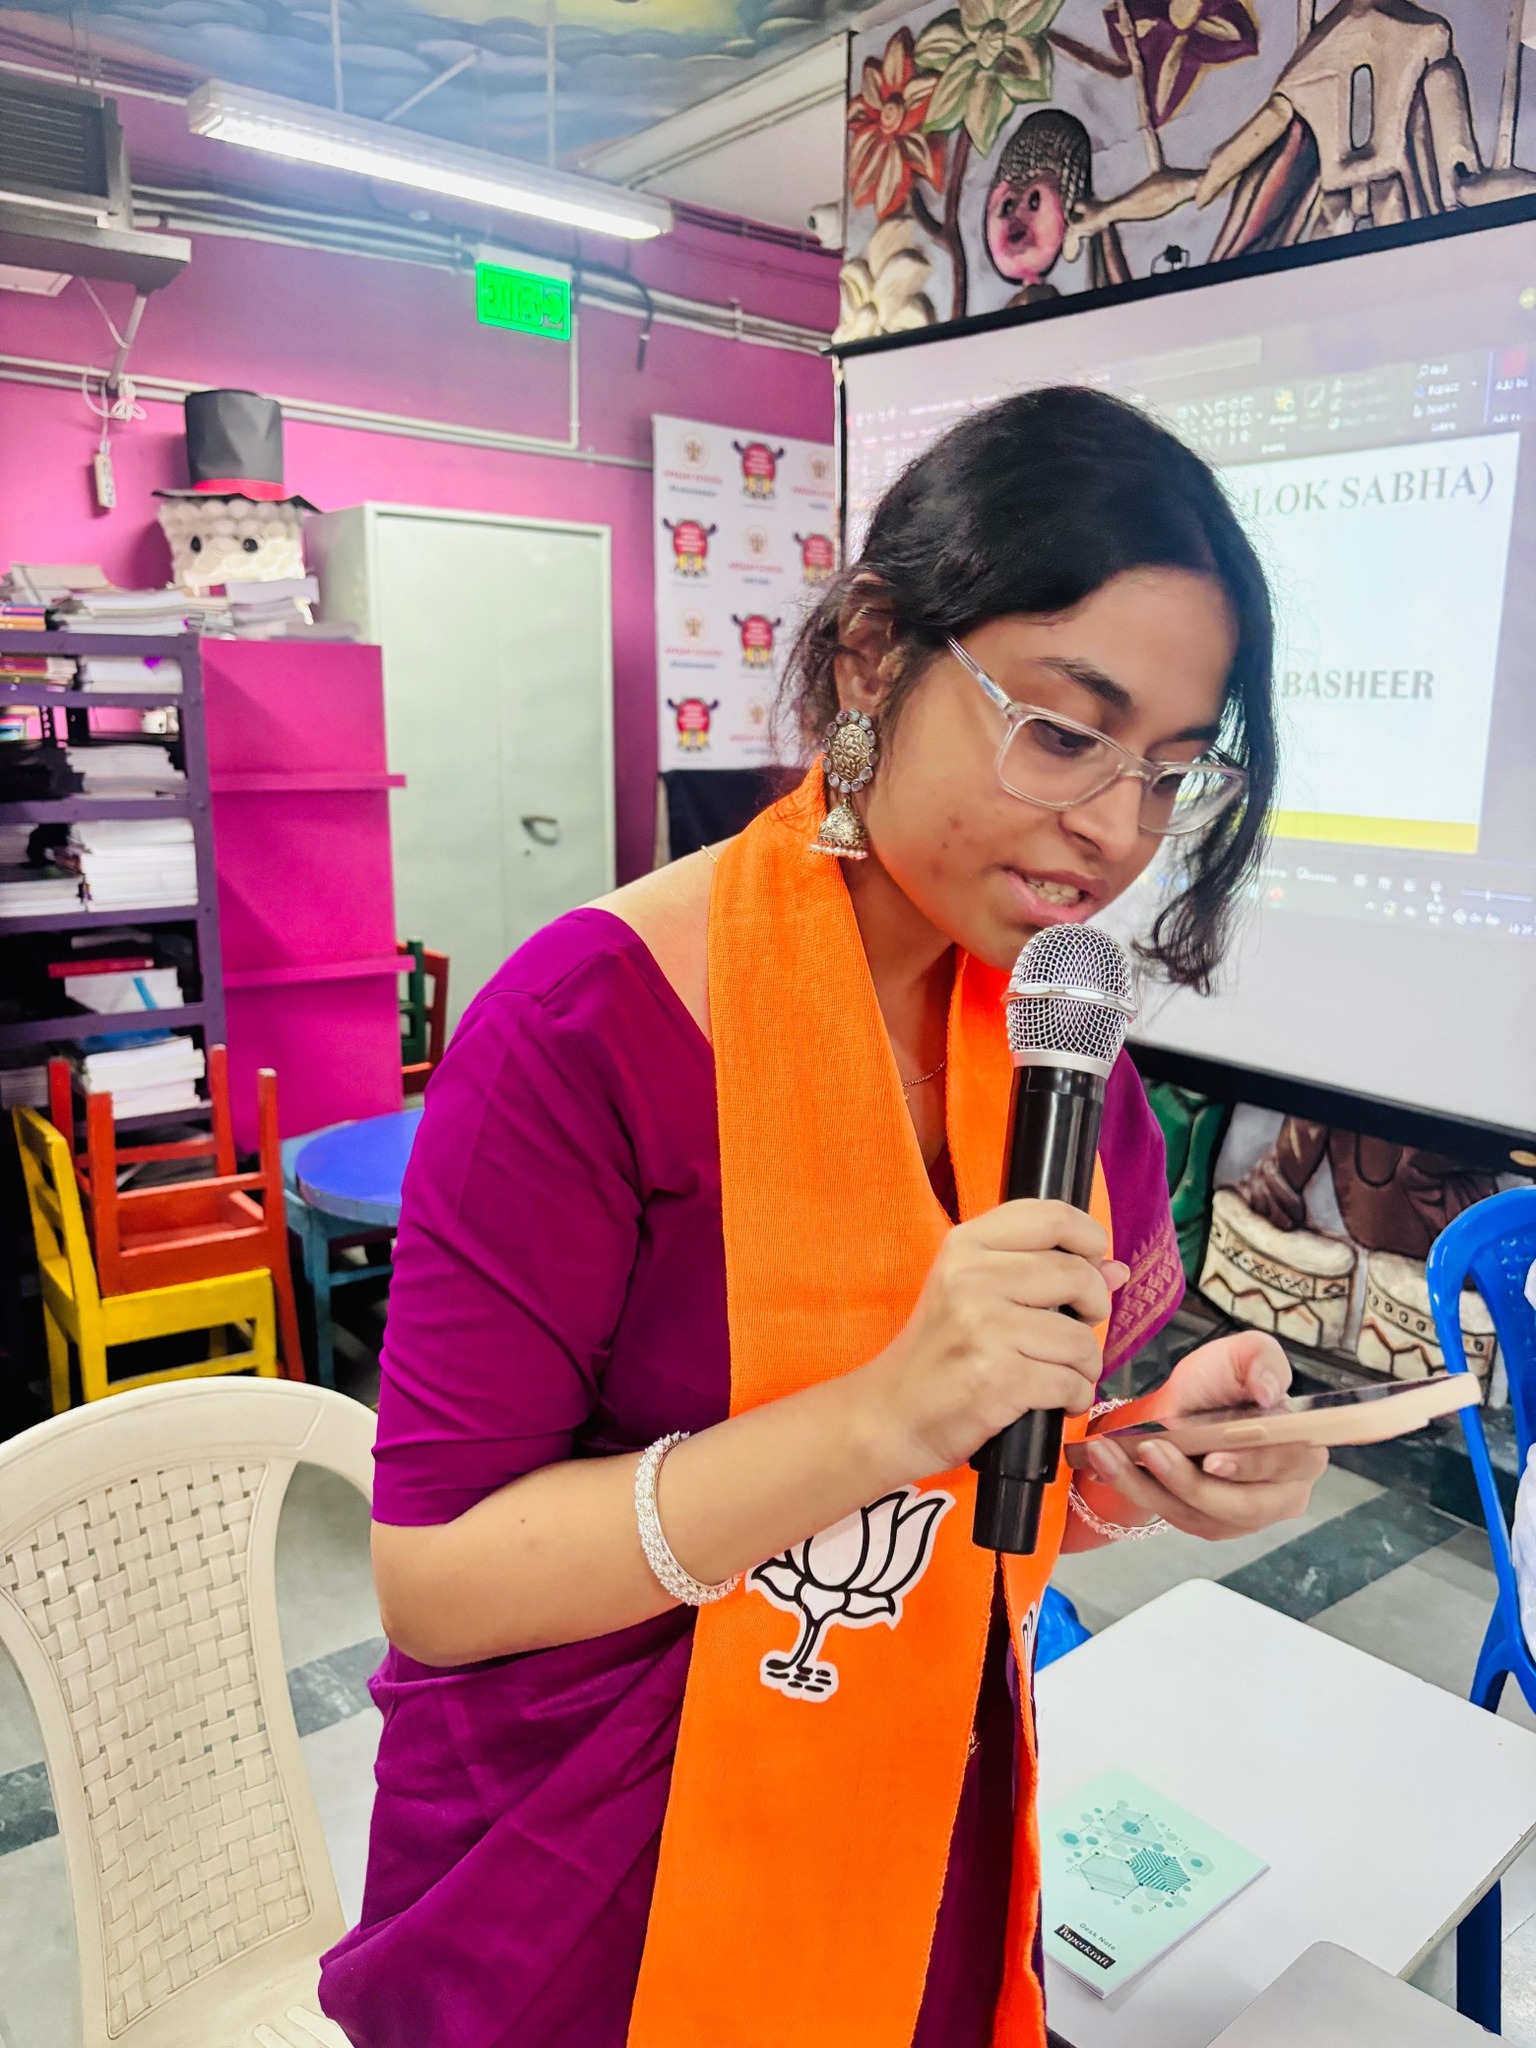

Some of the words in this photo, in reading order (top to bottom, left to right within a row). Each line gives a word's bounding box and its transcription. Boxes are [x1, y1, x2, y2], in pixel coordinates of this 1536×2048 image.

[1338, 462, 1494, 509] SABHA)
[1282, 669, 1435, 700] BASHEER
[1059, 1925, 1110, 1967] Paperkraft
[1098, 1936, 1116, 1951] Note
